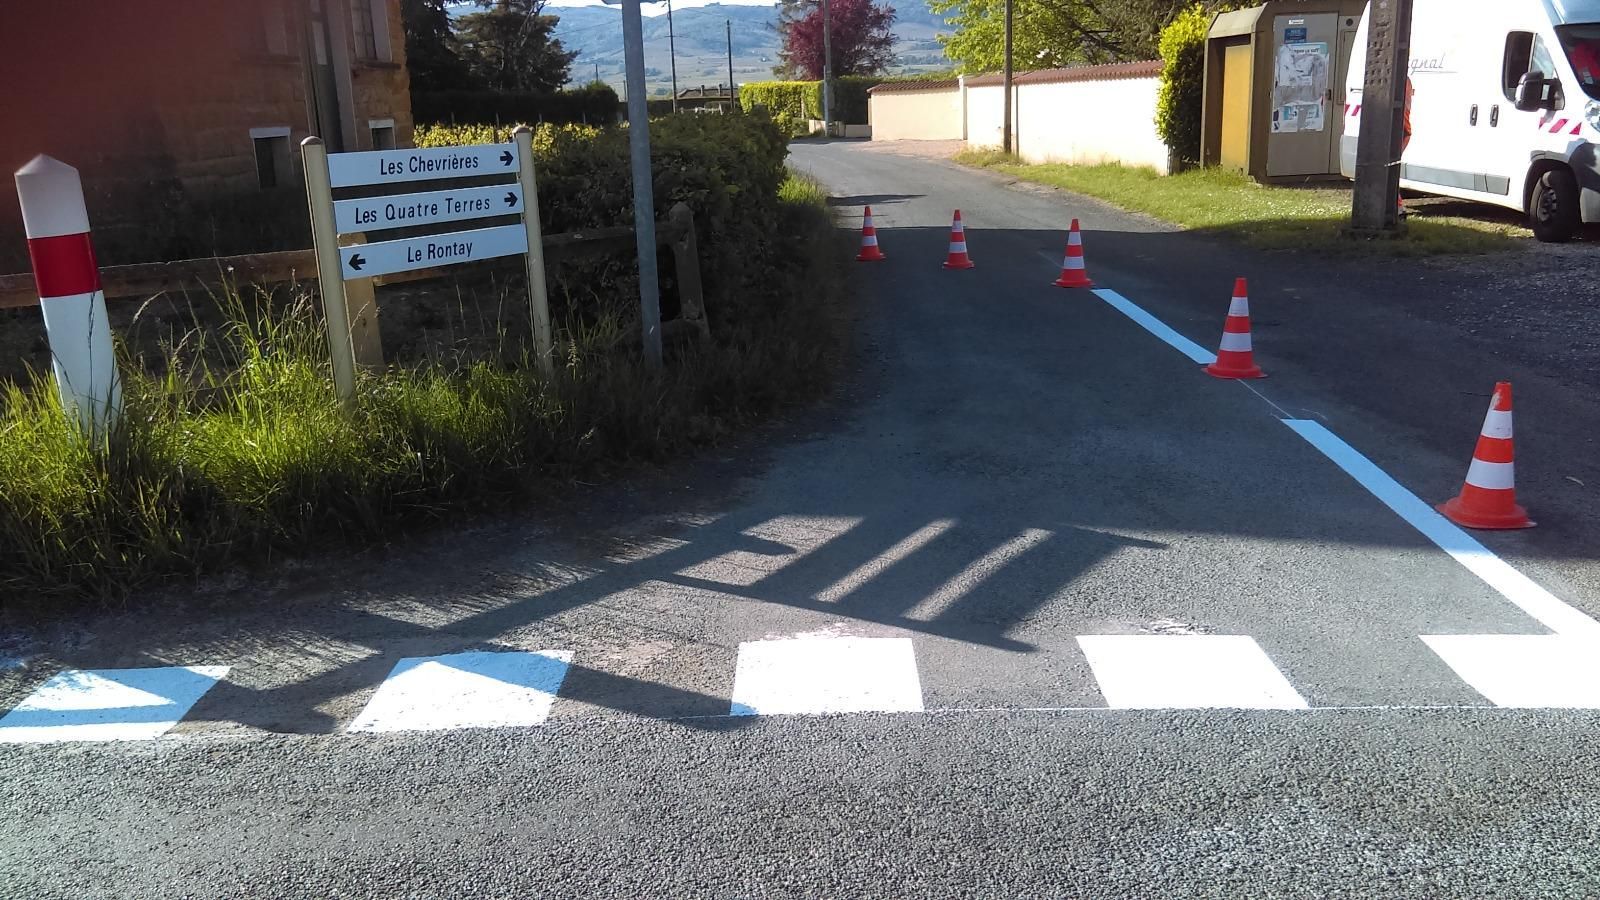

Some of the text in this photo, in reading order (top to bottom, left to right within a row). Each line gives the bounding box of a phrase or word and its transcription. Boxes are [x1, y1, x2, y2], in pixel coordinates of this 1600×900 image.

[1409, 52, 1446, 75] gnal
[380, 154, 479, 175] Les Chevrières
[355, 197, 490, 224] Les Quatre Terres
[407, 242, 473, 263] Le Rontay
